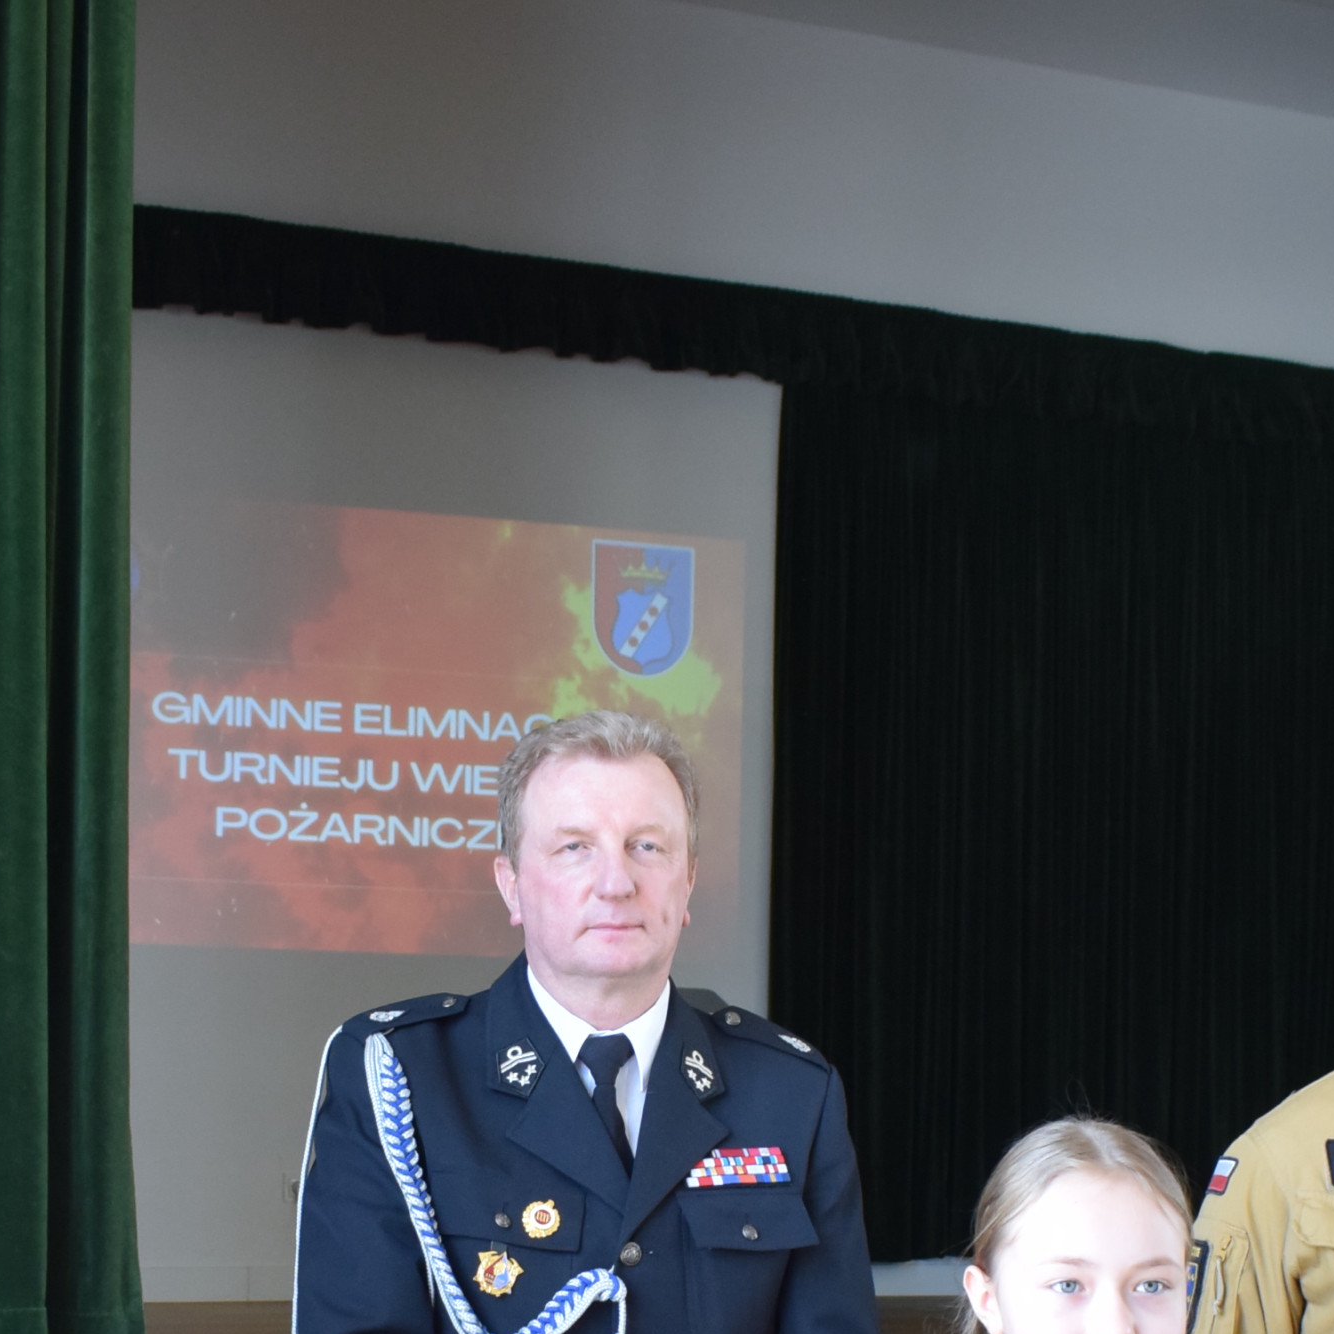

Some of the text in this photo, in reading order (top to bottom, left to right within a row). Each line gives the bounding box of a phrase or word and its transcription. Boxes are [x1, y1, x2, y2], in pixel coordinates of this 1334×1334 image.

[152, 691, 342, 733] GMINNE
[168, 748, 399, 792] TURNIEJU
[215, 802, 503, 850] POŻARNICZ
